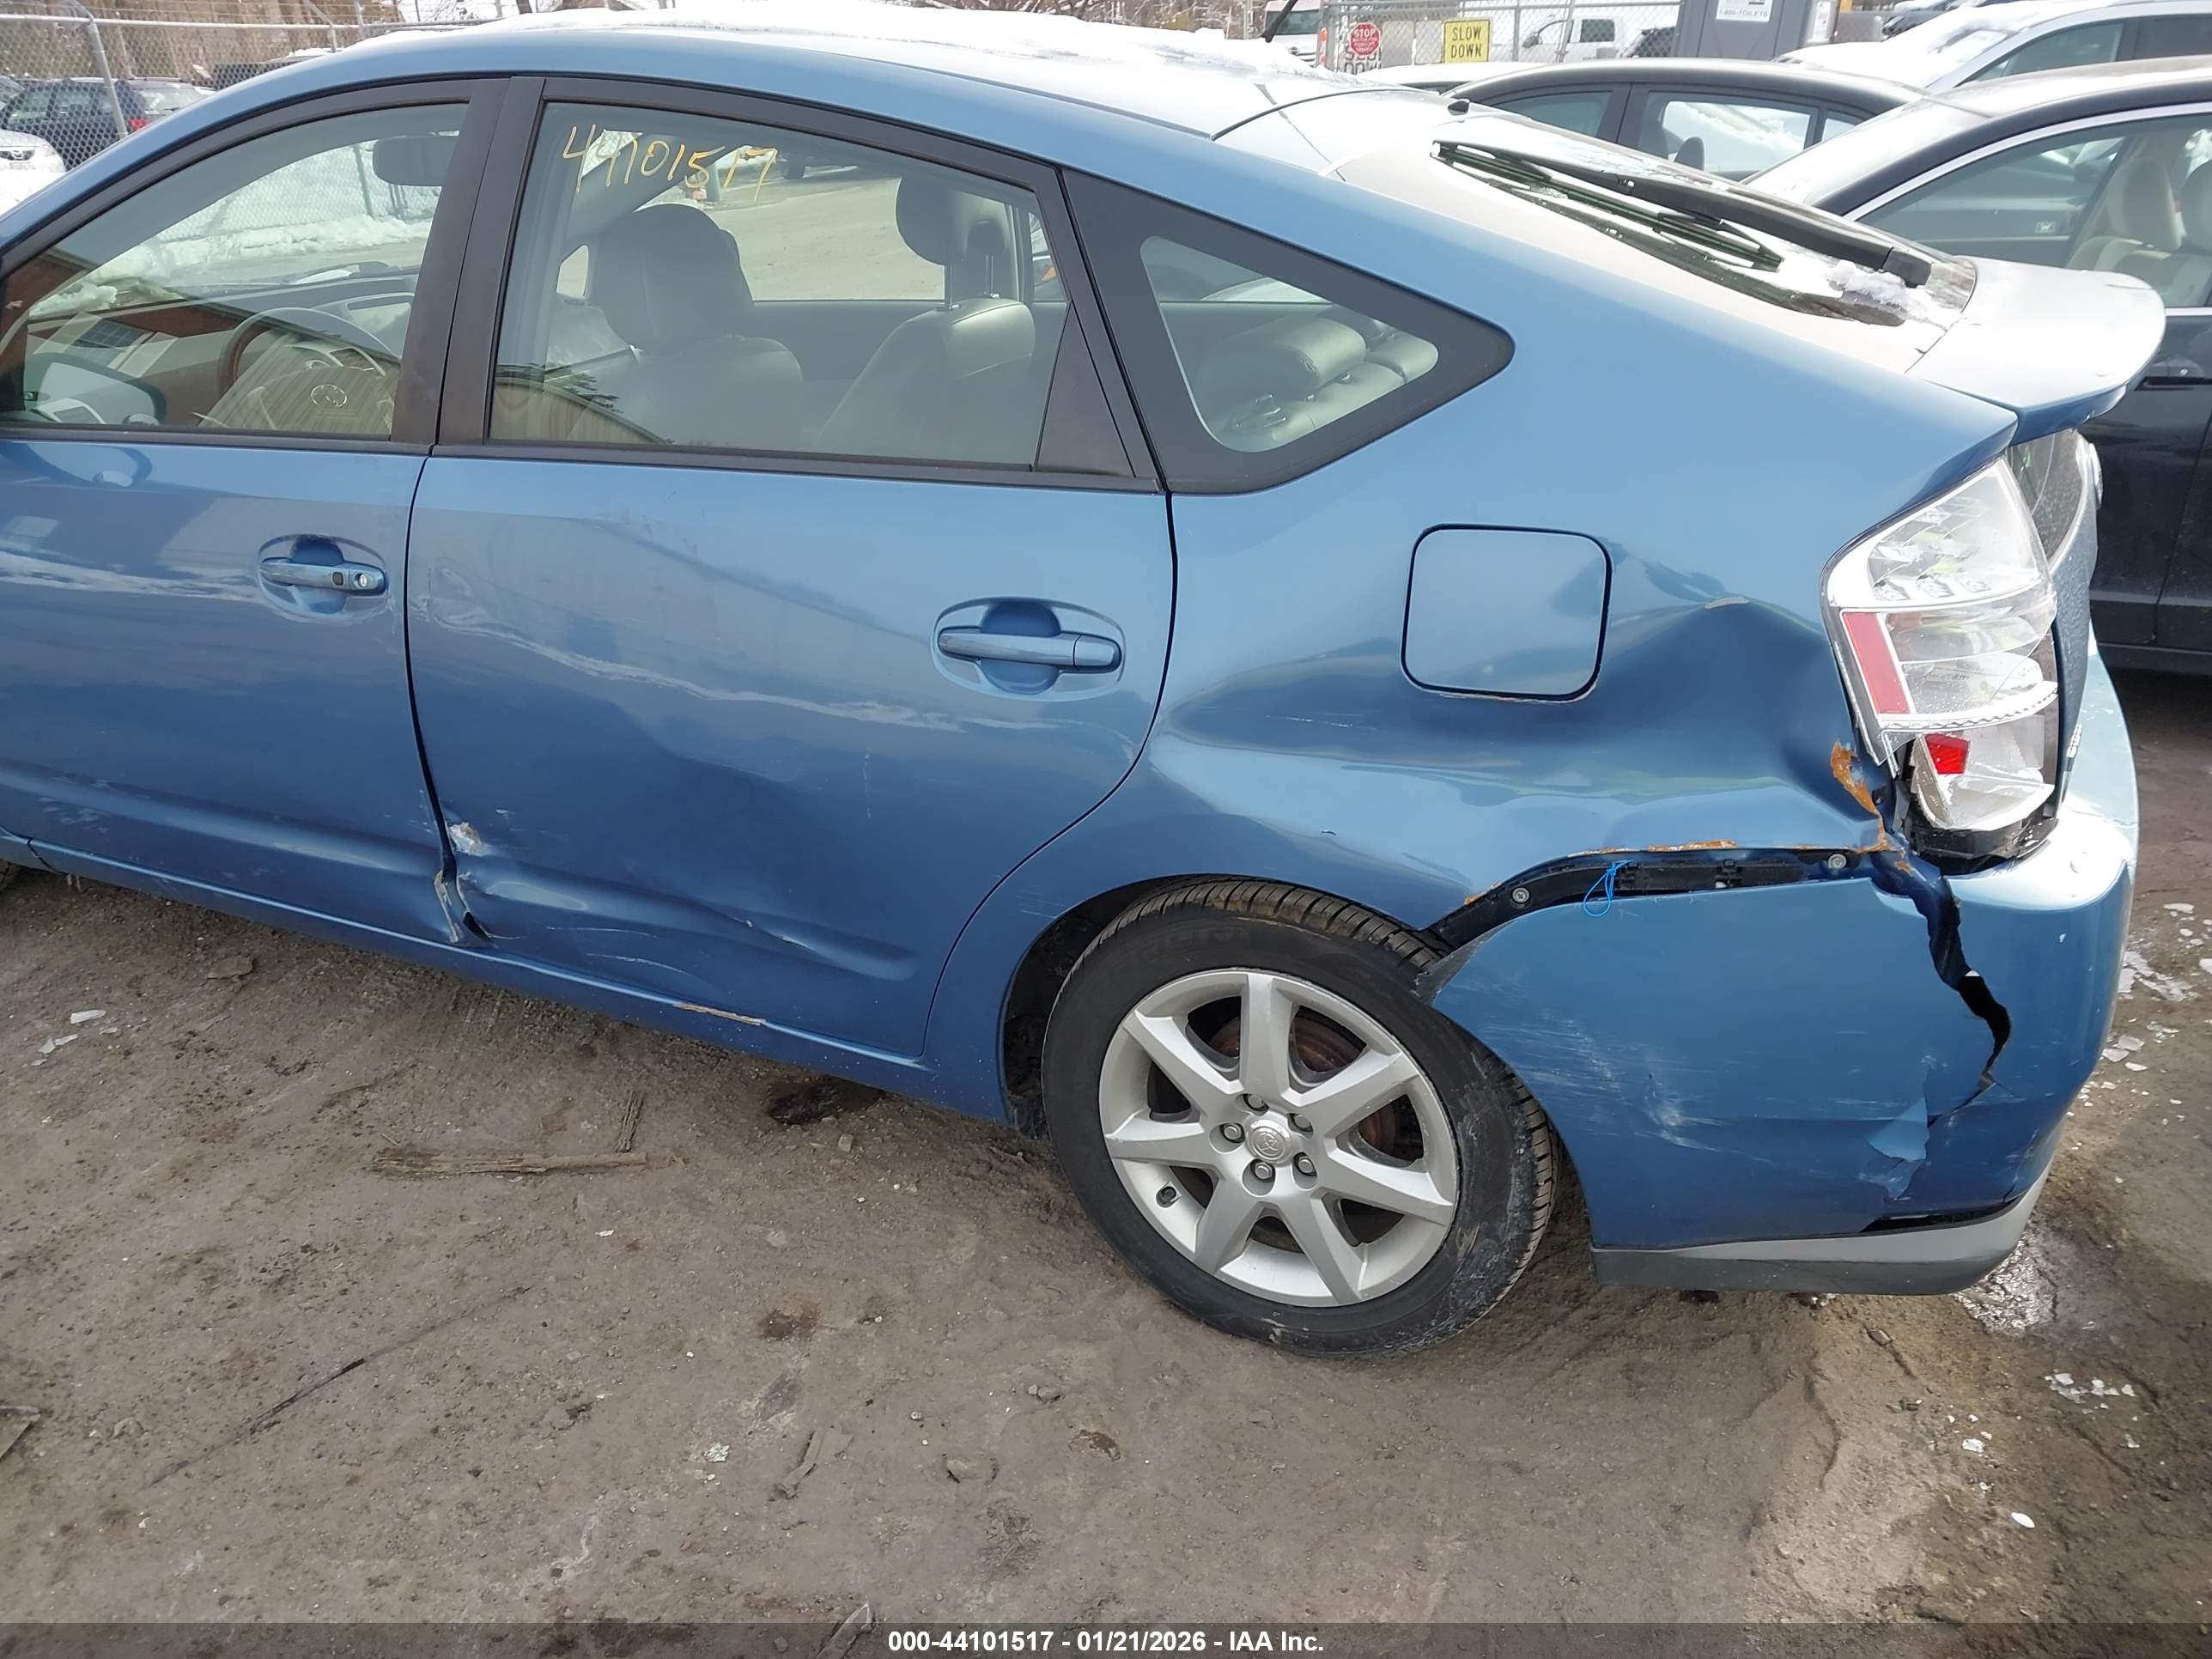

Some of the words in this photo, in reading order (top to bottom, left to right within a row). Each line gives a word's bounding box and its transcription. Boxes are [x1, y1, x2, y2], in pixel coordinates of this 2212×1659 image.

[1354, 27, 1376, 38] STOP
[1451, 26, 1482, 41] SLOW
[1450, 43, 1482, 58] DOWN
